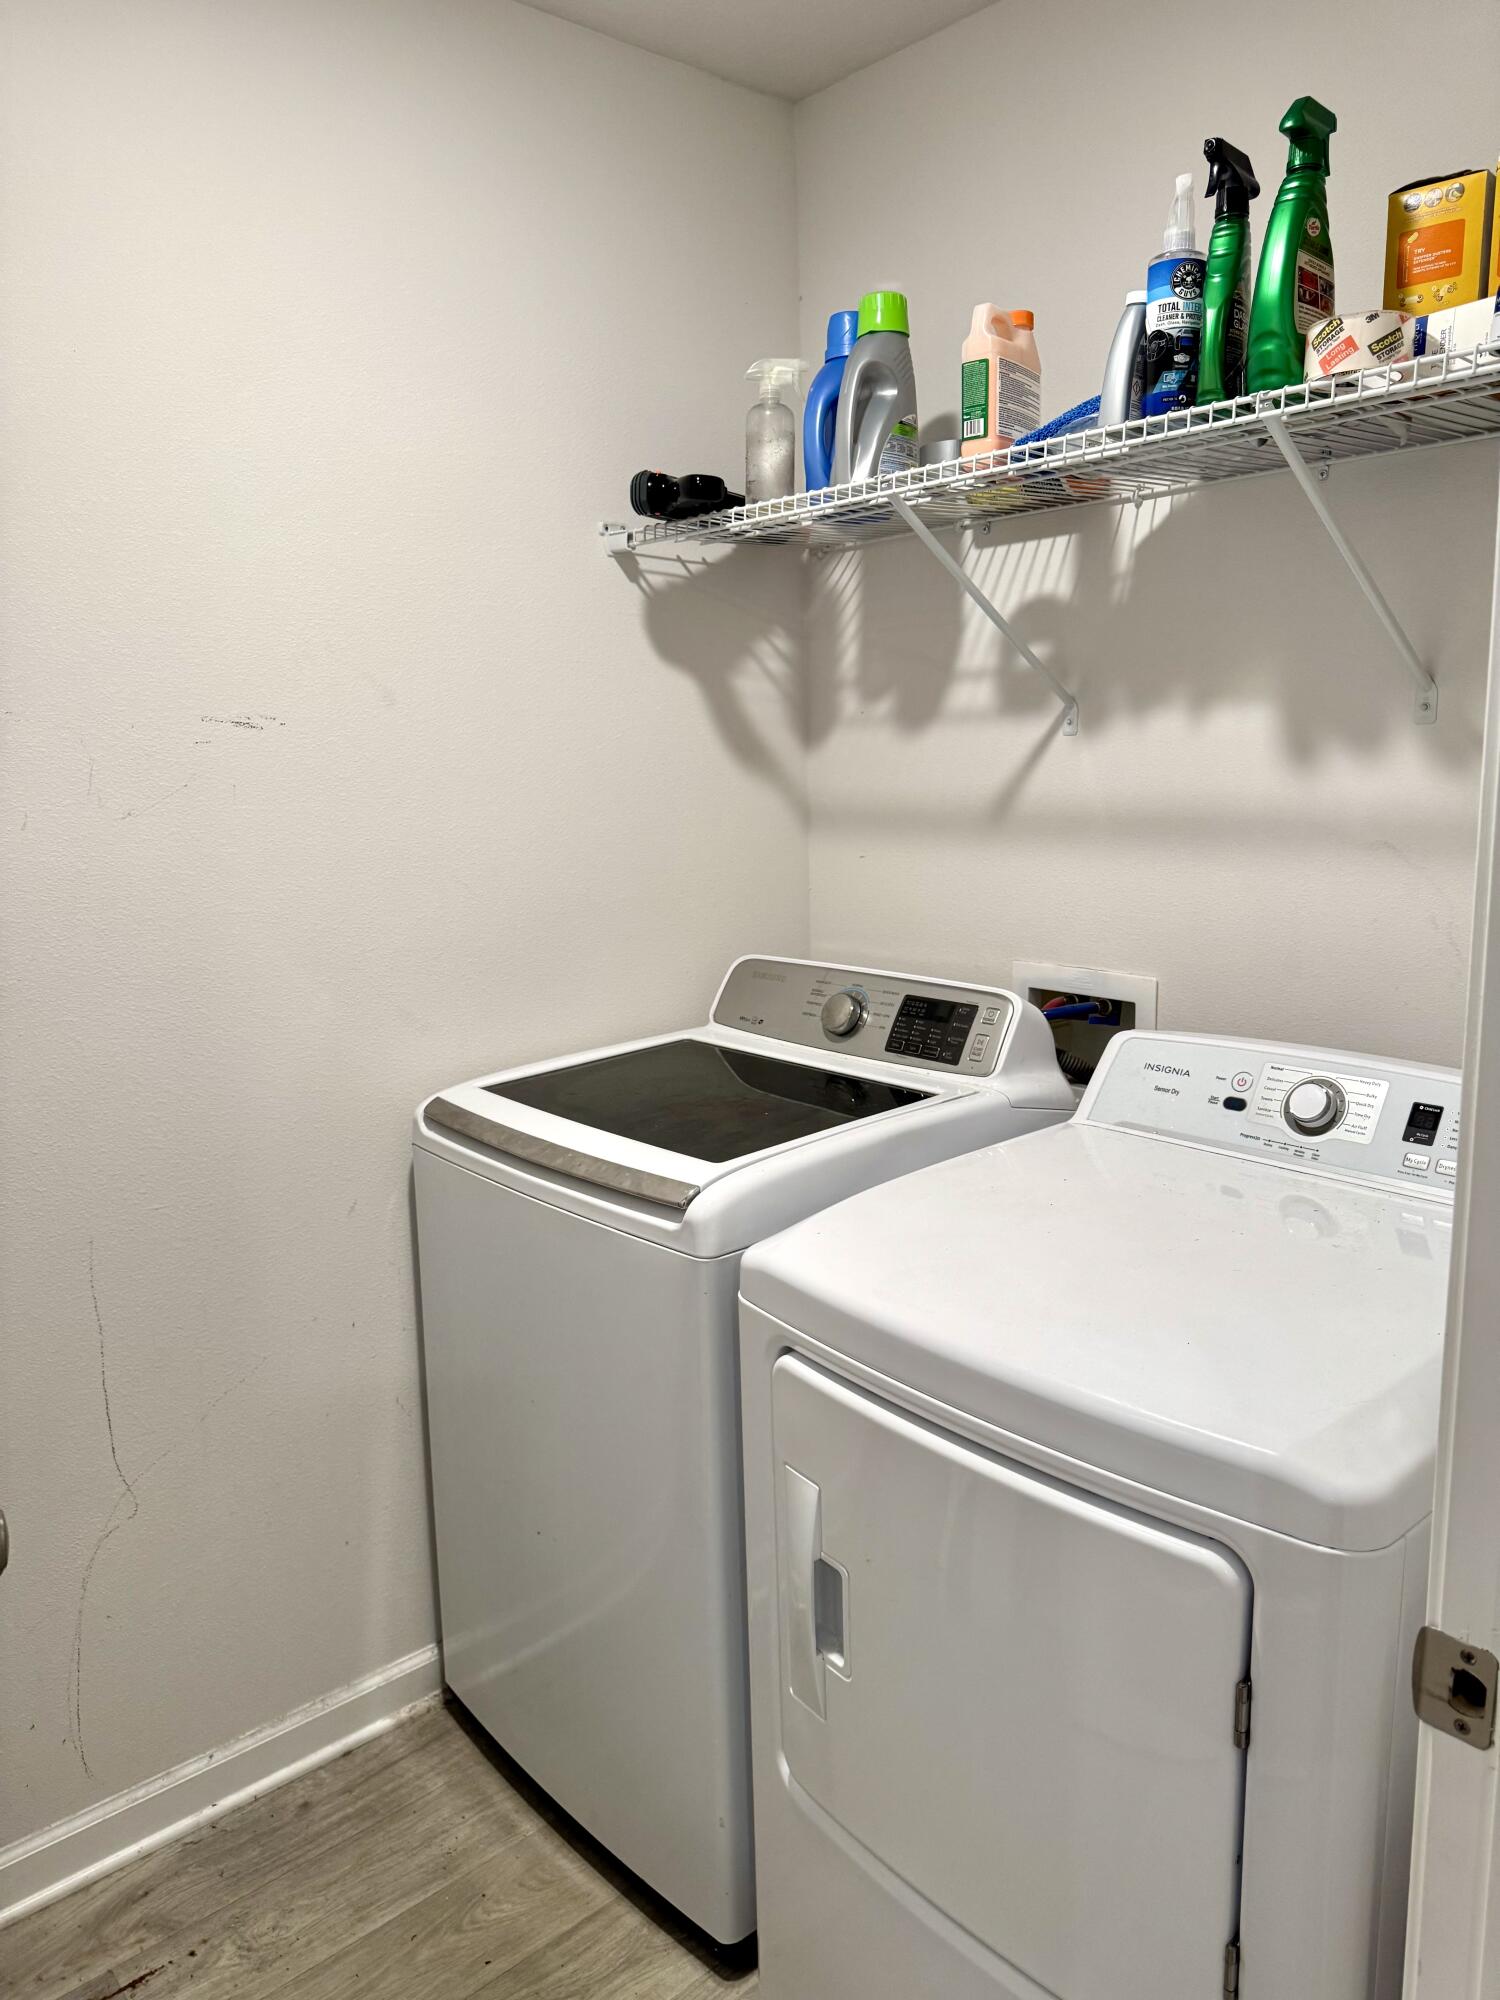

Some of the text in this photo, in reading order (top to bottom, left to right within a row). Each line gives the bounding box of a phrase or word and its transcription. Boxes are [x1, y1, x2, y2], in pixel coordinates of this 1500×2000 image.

[1413, 247, 1426, 255] TRY
[1173, 263, 1202, 283] CHEMICAL
[1178, 288, 1198, 298] GUYS
[1157, 301, 1181, 313] TOTAL
[1156, 312, 1180, 323] CLEANER
[1364, 312, 1380, 324] 3M
[1312, 317, 1342, 347] Scotch
[1315, 325, 1346, 355] STORAGE
[1370, 329, 1403, 353] Scotch
[1325, 341, 1347, 360] Long
[1375, 340, 1405, 361] STORAGE
[1324, 346, 1356, 371] Lasting
[1143, 1062, 1191, 1078] INSIGNIA
[1153, 1084, 1180, 1097] Sensor Dry
[1406, 1156, 1427, 1166] My Cycle
[1438, 1163, 1457, 1172] Drynes
